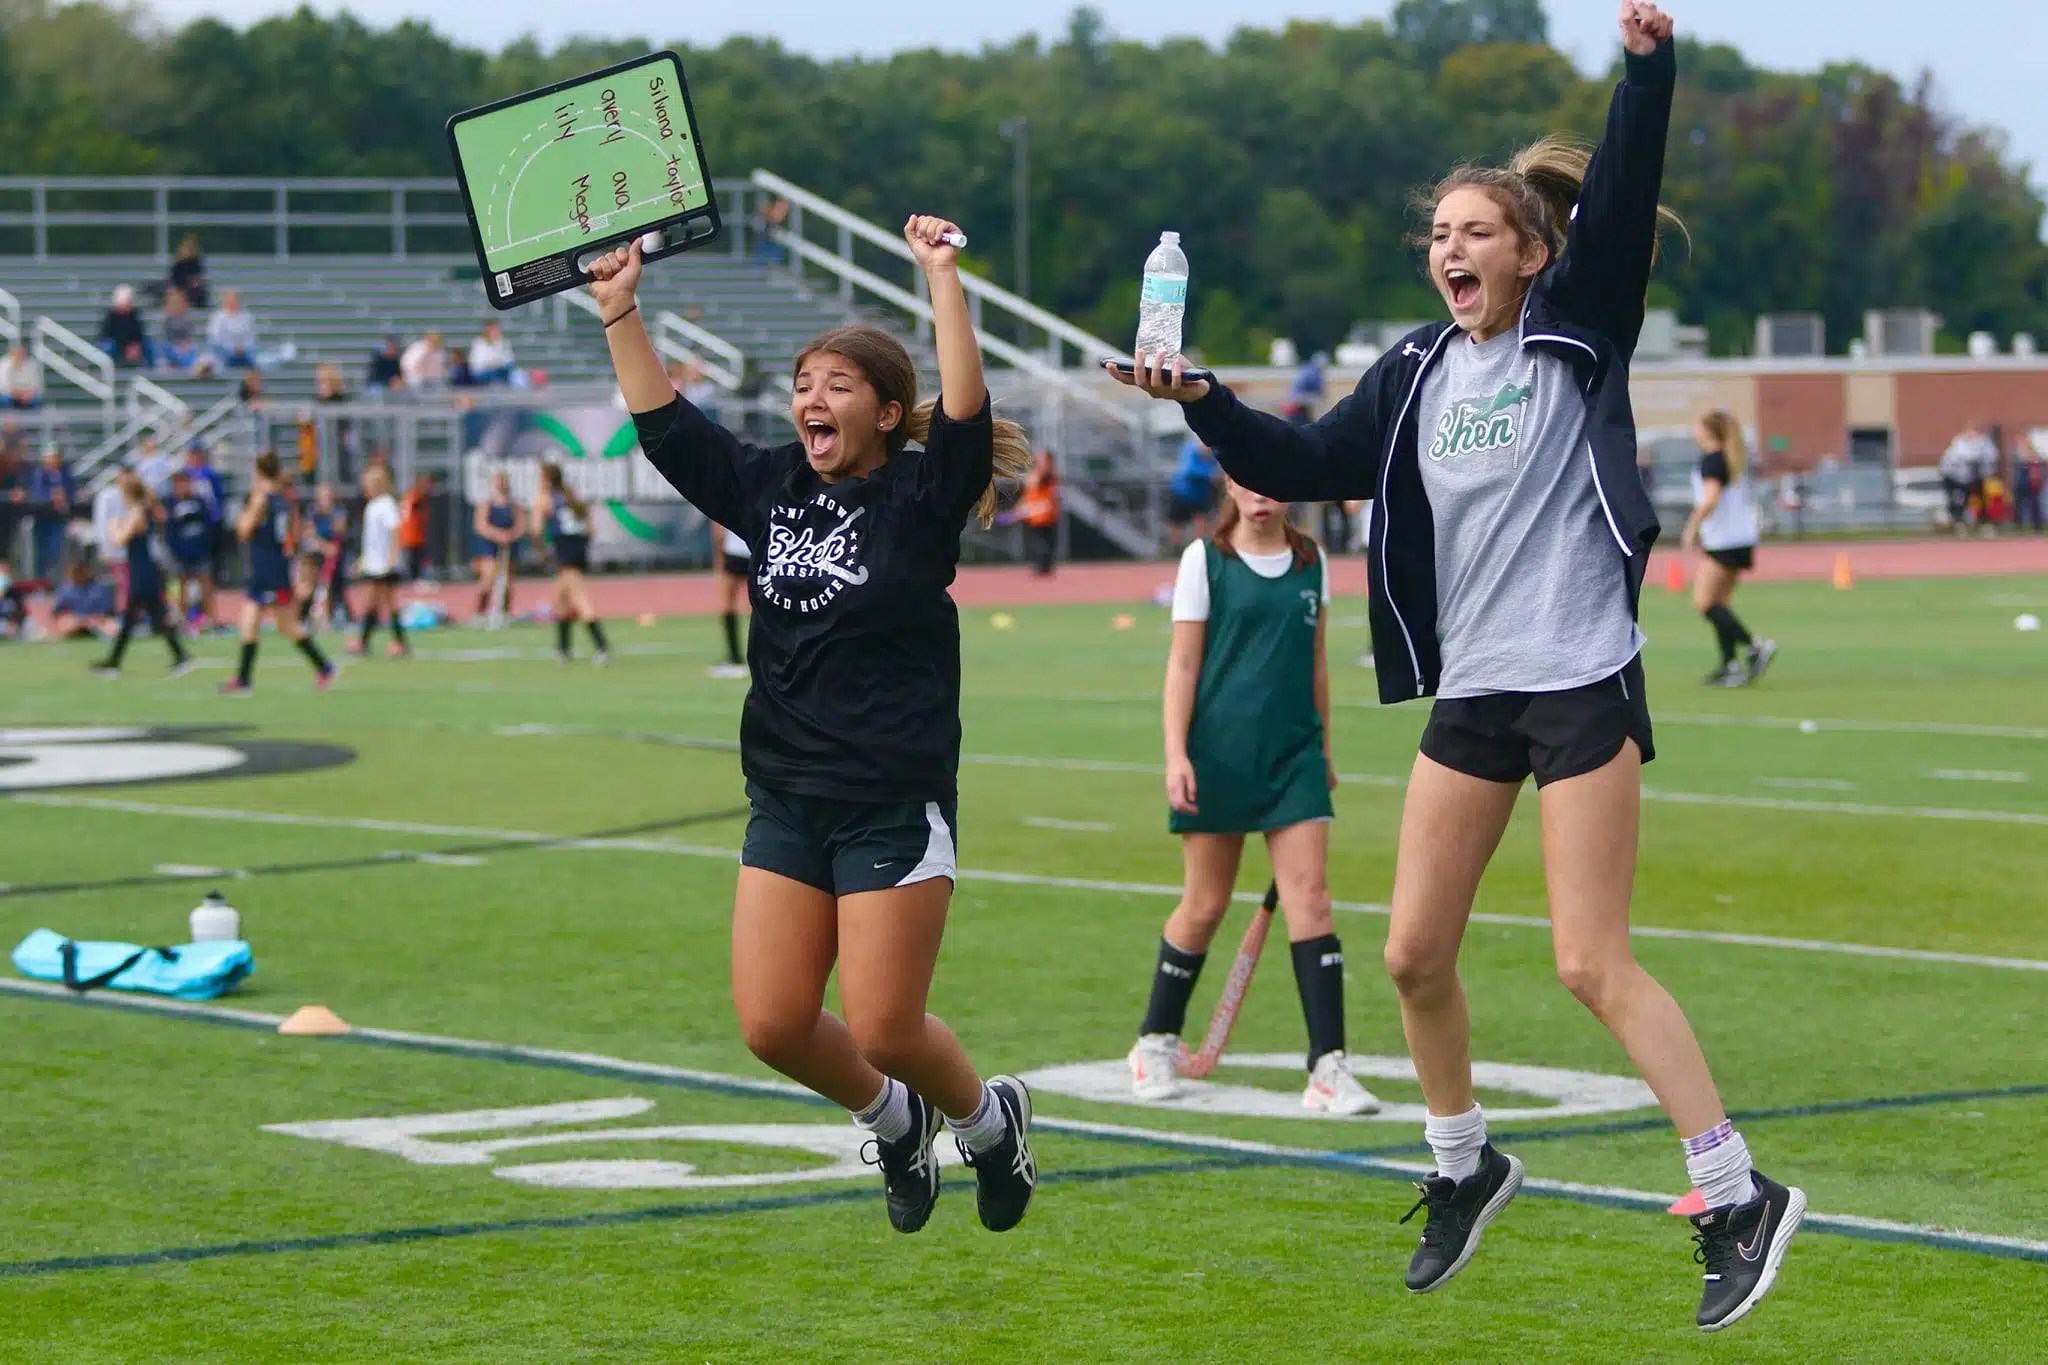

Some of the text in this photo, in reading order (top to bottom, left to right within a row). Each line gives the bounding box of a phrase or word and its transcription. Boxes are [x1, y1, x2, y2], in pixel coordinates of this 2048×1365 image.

[649, 76, 674, 140] Silvana
[599, 88, 631, 210] avery ava
[569, 174, 591, 235] Megan
[1428, 403, 1517, 462] Shen
